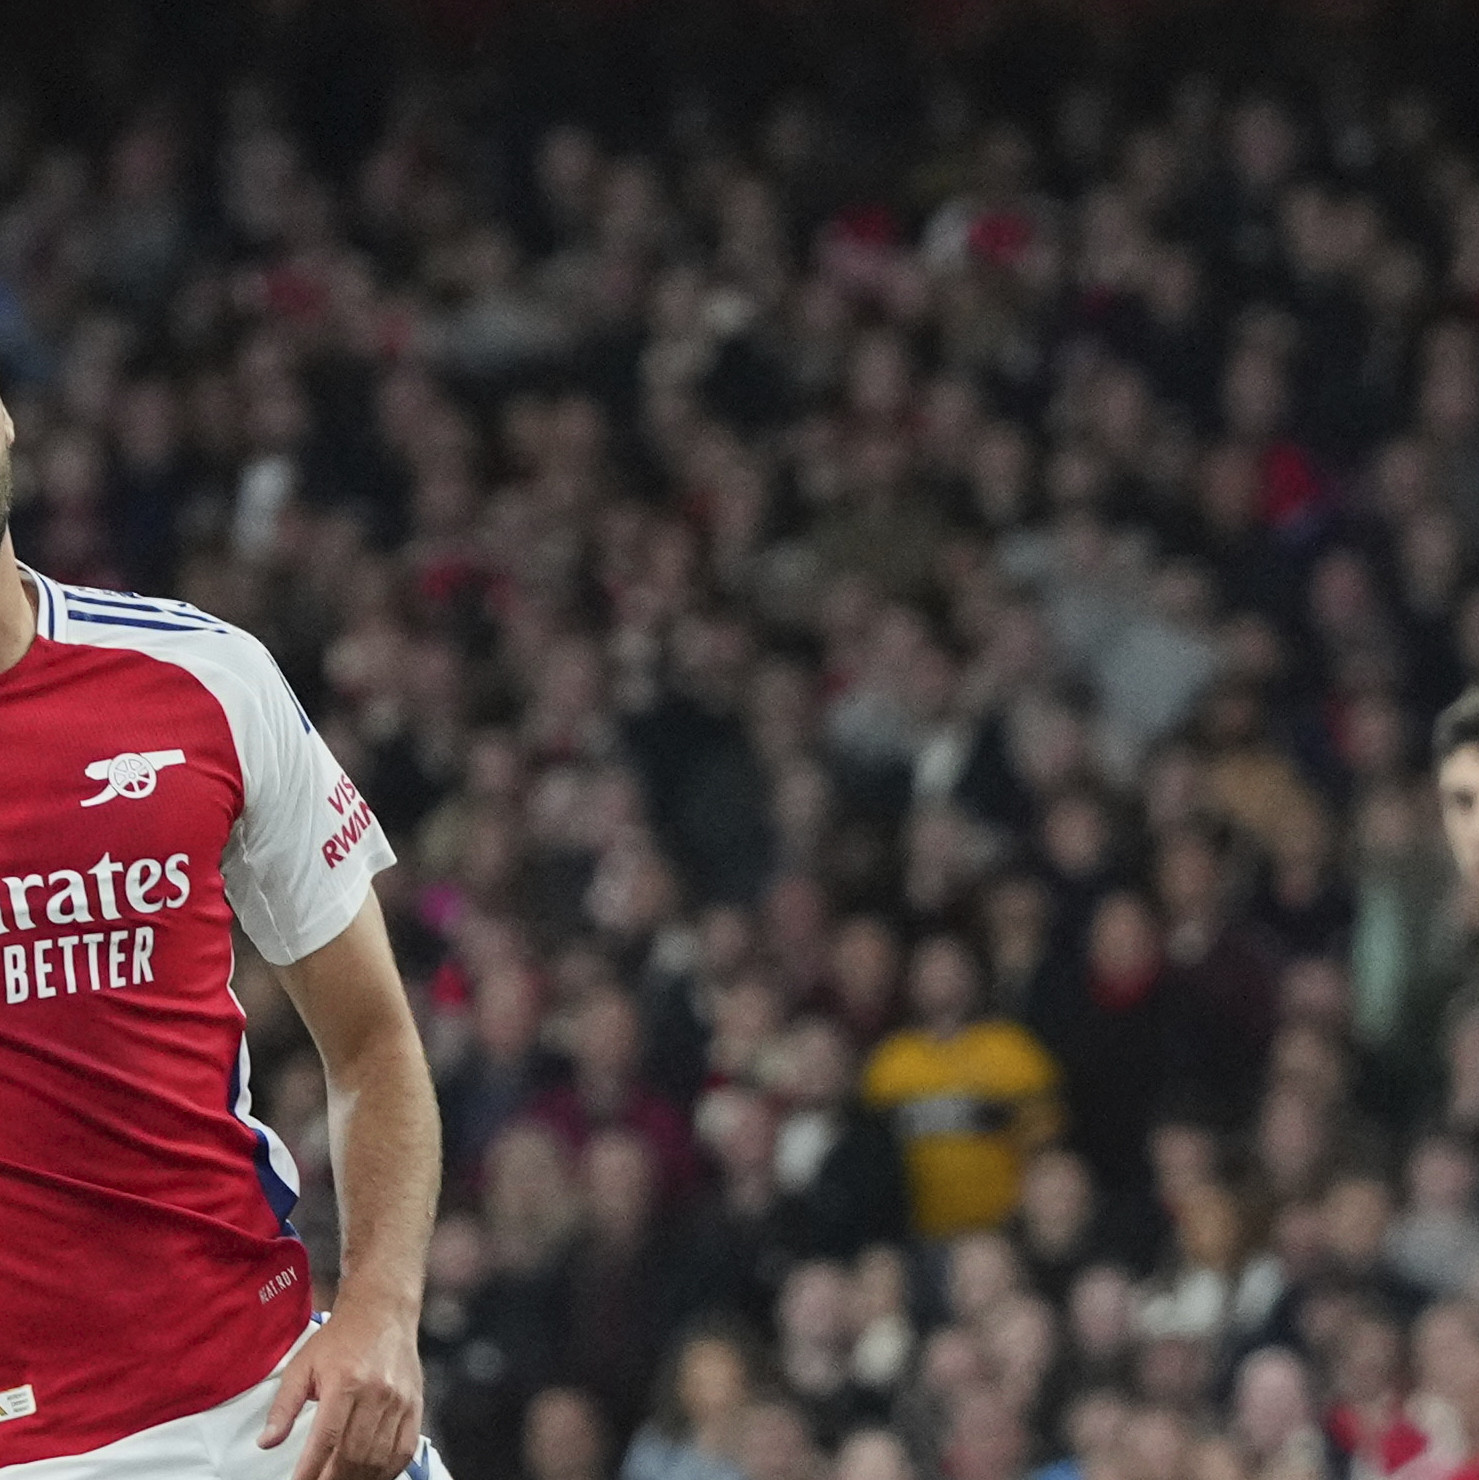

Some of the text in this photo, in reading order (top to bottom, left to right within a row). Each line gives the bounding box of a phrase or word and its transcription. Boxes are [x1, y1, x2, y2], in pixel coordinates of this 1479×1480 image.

[326, 772, 357, 816] VIS
[321, 799, 372, 870] RWAN
[5, 926, 154, 1004] BETTER
